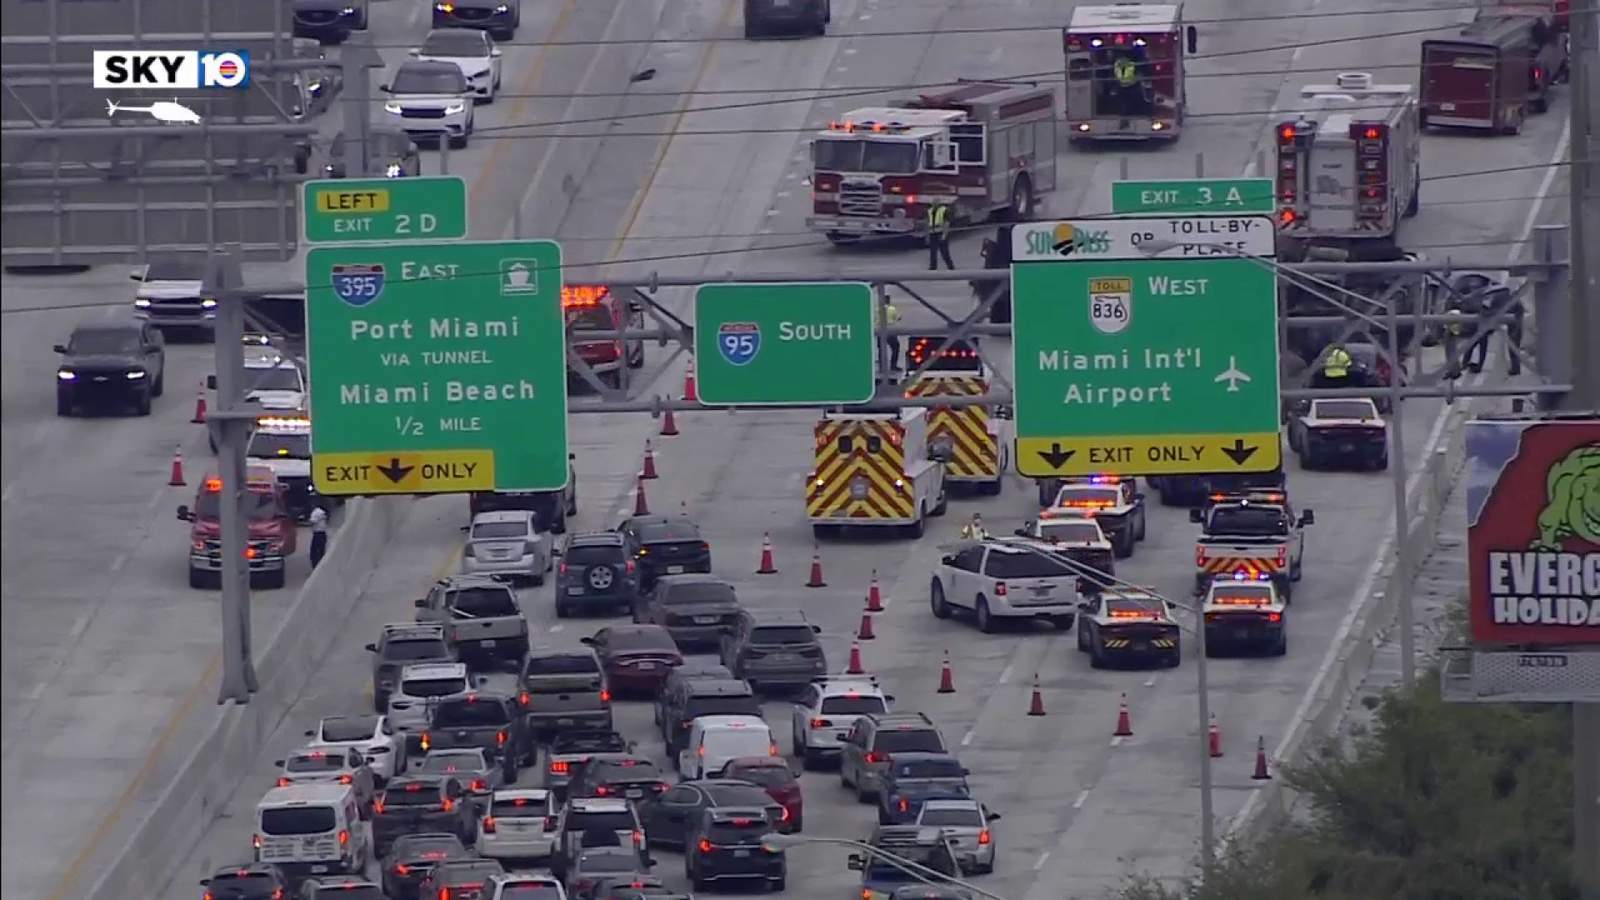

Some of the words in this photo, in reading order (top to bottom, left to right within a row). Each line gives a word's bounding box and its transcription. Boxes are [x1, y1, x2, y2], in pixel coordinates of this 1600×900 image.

[326, 192, 378, 210] LEFT
[1141, 190, 1179, 205] EXIT
[1197, 187, 1214, 205] 3
[1225, 187, 1244, 206] A
[333, 217, 372, 233] EXIT
[394, 215, 411, 233] 2
[420, 214, 437, 233] D
[1168, 219, 1261, 234] TOLL-BY-
[341, 276, 376, 296] 395
[1096, 281, 1123, 290] TOLL
[1092, 303, 1123, 319] 836
[350, 319, 413, 340] Port
[430, 316, 520, 339] Miami
[725, 335, 754, 356] 95
[380, 353, 411, 367] VIA
[421, 350, 493, 366] TUNNEL
[1039, 349, 1130, 371] Miami
[1145, 347, 1202, 369] Int'l
[340, 382, 429, 404] Miami
[446, 379, 535, 402] Beach
[1063, 381, 1172, 408] Airport
[439, 417, 483, 432] MILE
[1089, 447, 1133, 464] EXIT
[1147, 445, 1206, 463] ONLY
[325, 465, 373, 482] EXIT
[421, 462, 478, 480] ONLY
